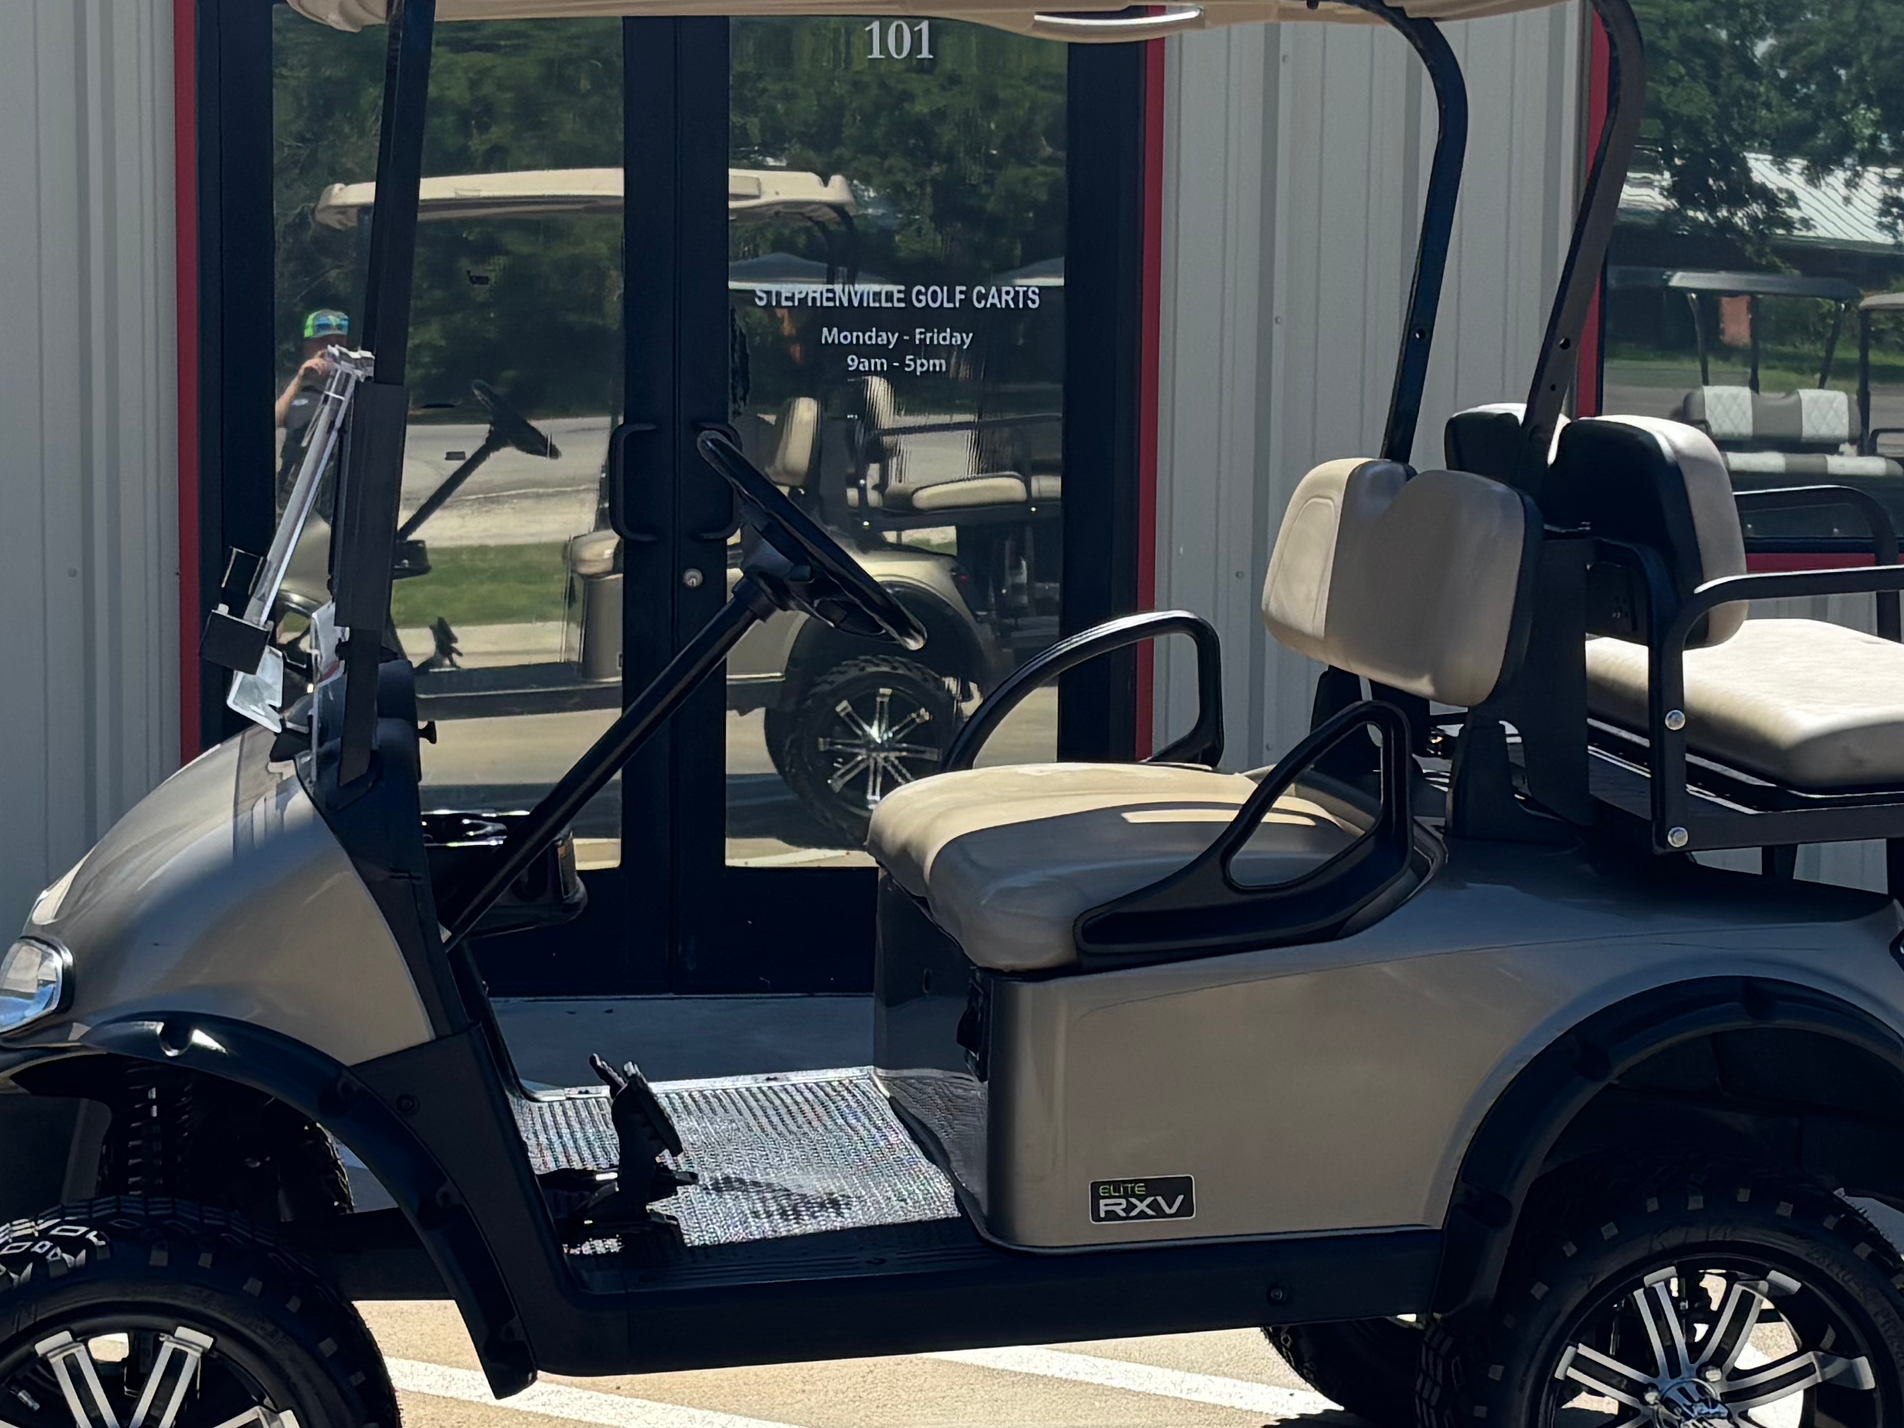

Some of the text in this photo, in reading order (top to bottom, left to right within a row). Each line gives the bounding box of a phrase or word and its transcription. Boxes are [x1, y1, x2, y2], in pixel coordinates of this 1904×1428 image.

[863, 19, 934, 60] 101
[754, 284, 1040, 309] STEPHENVILLE GOLF CARTS
[820, 327, 899, 349] Monday
[914, 327, 974, 349] Friday
[846, 354, 888, 372] 9am
[904, 355, 947, 376] 5pm
[1099, 1183, 1146, 1196] ELITE
[1099, 1194, 1184, 1218] RXV
